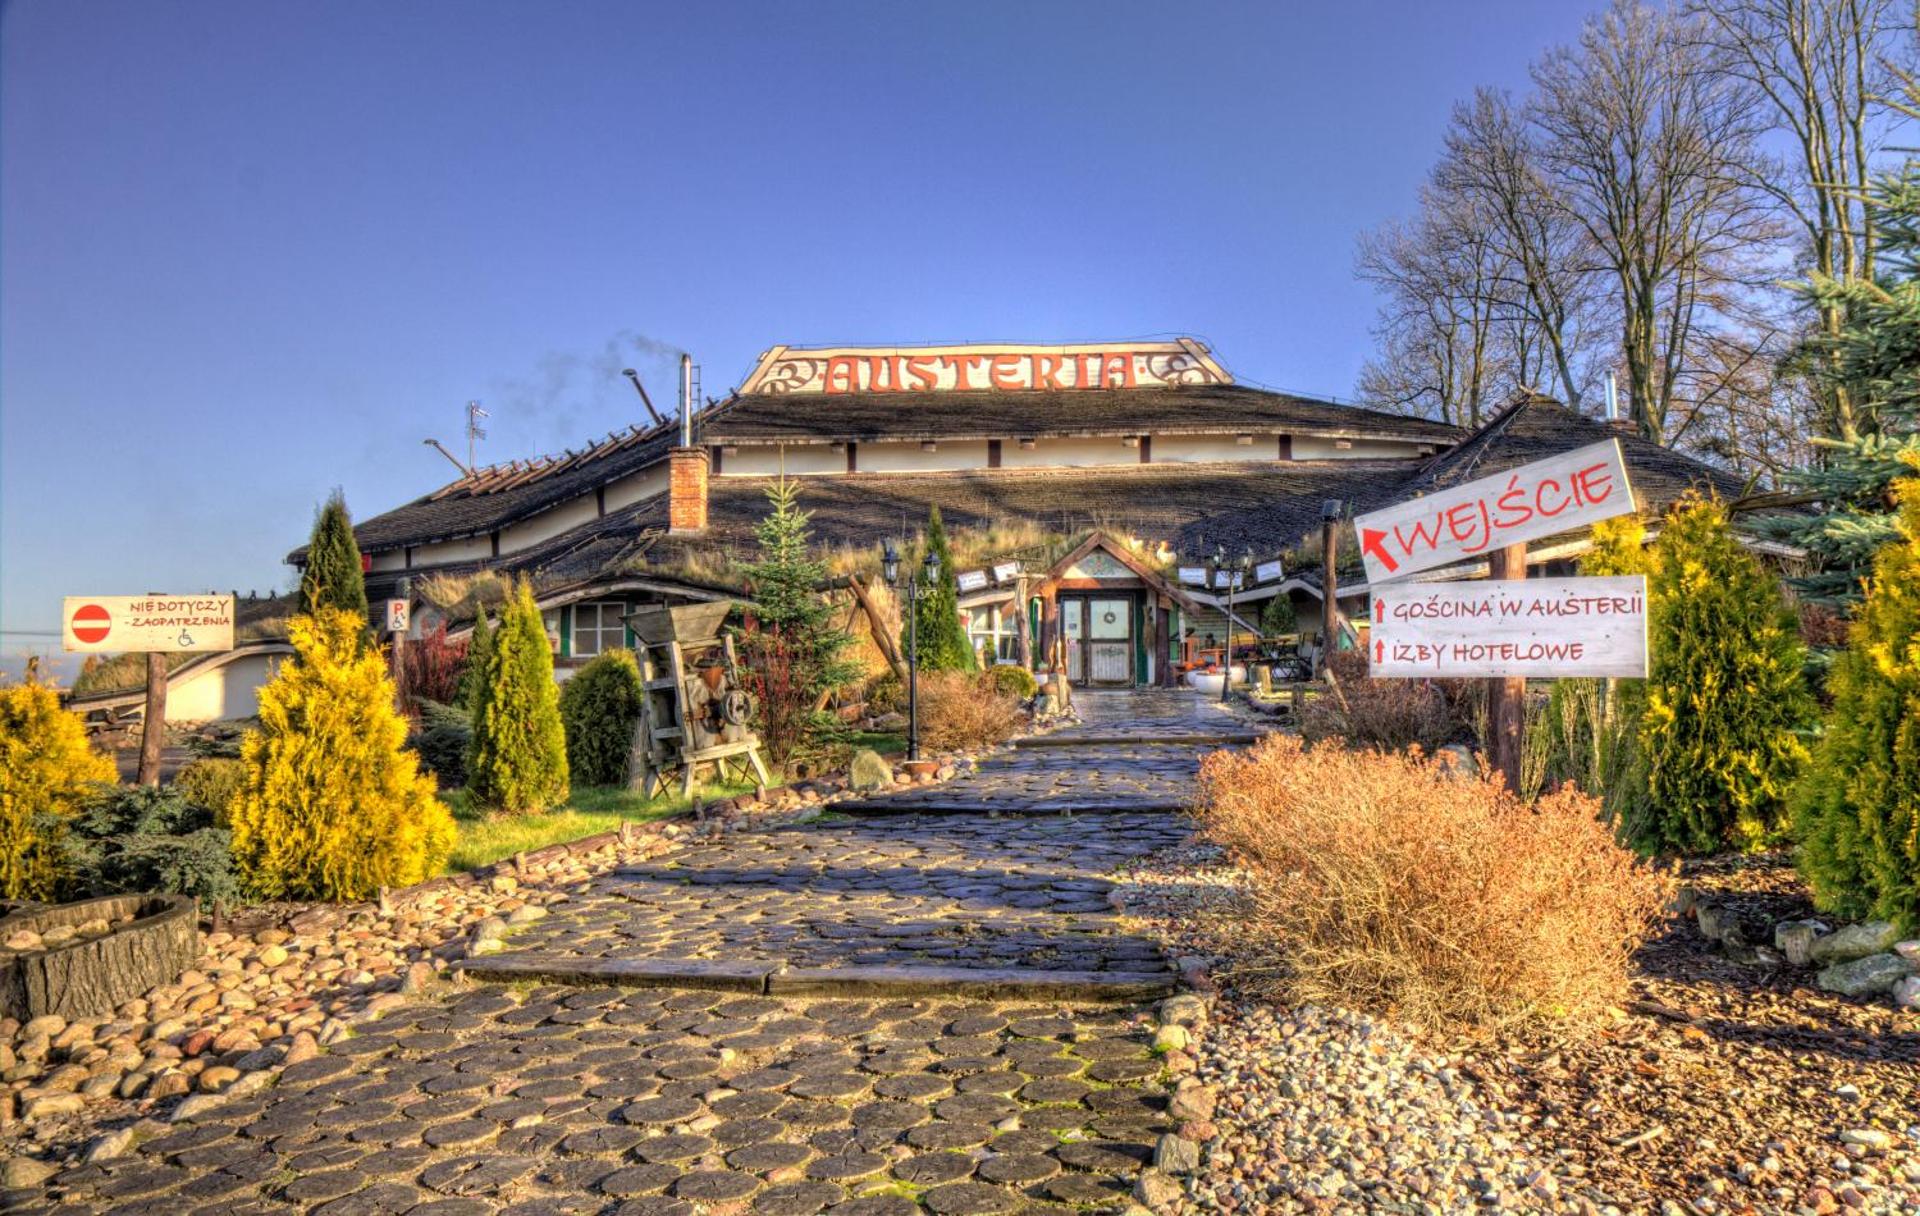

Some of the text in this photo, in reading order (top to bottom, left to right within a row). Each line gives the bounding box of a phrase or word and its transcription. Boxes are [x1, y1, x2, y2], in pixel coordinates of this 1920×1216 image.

[823, 351, 1138, 395] AUSTERIA
[1393, 462, 1613, 556] WEJŚCIE
[130, 600, 229, 615] NIE DOTYCZY
[394, 602, 404, 615] P
[1393, 594, 1642, 622] GOŚCINA W AUSTERII
[1393, 642, 1584, 669] IZBY HOTELOWE
